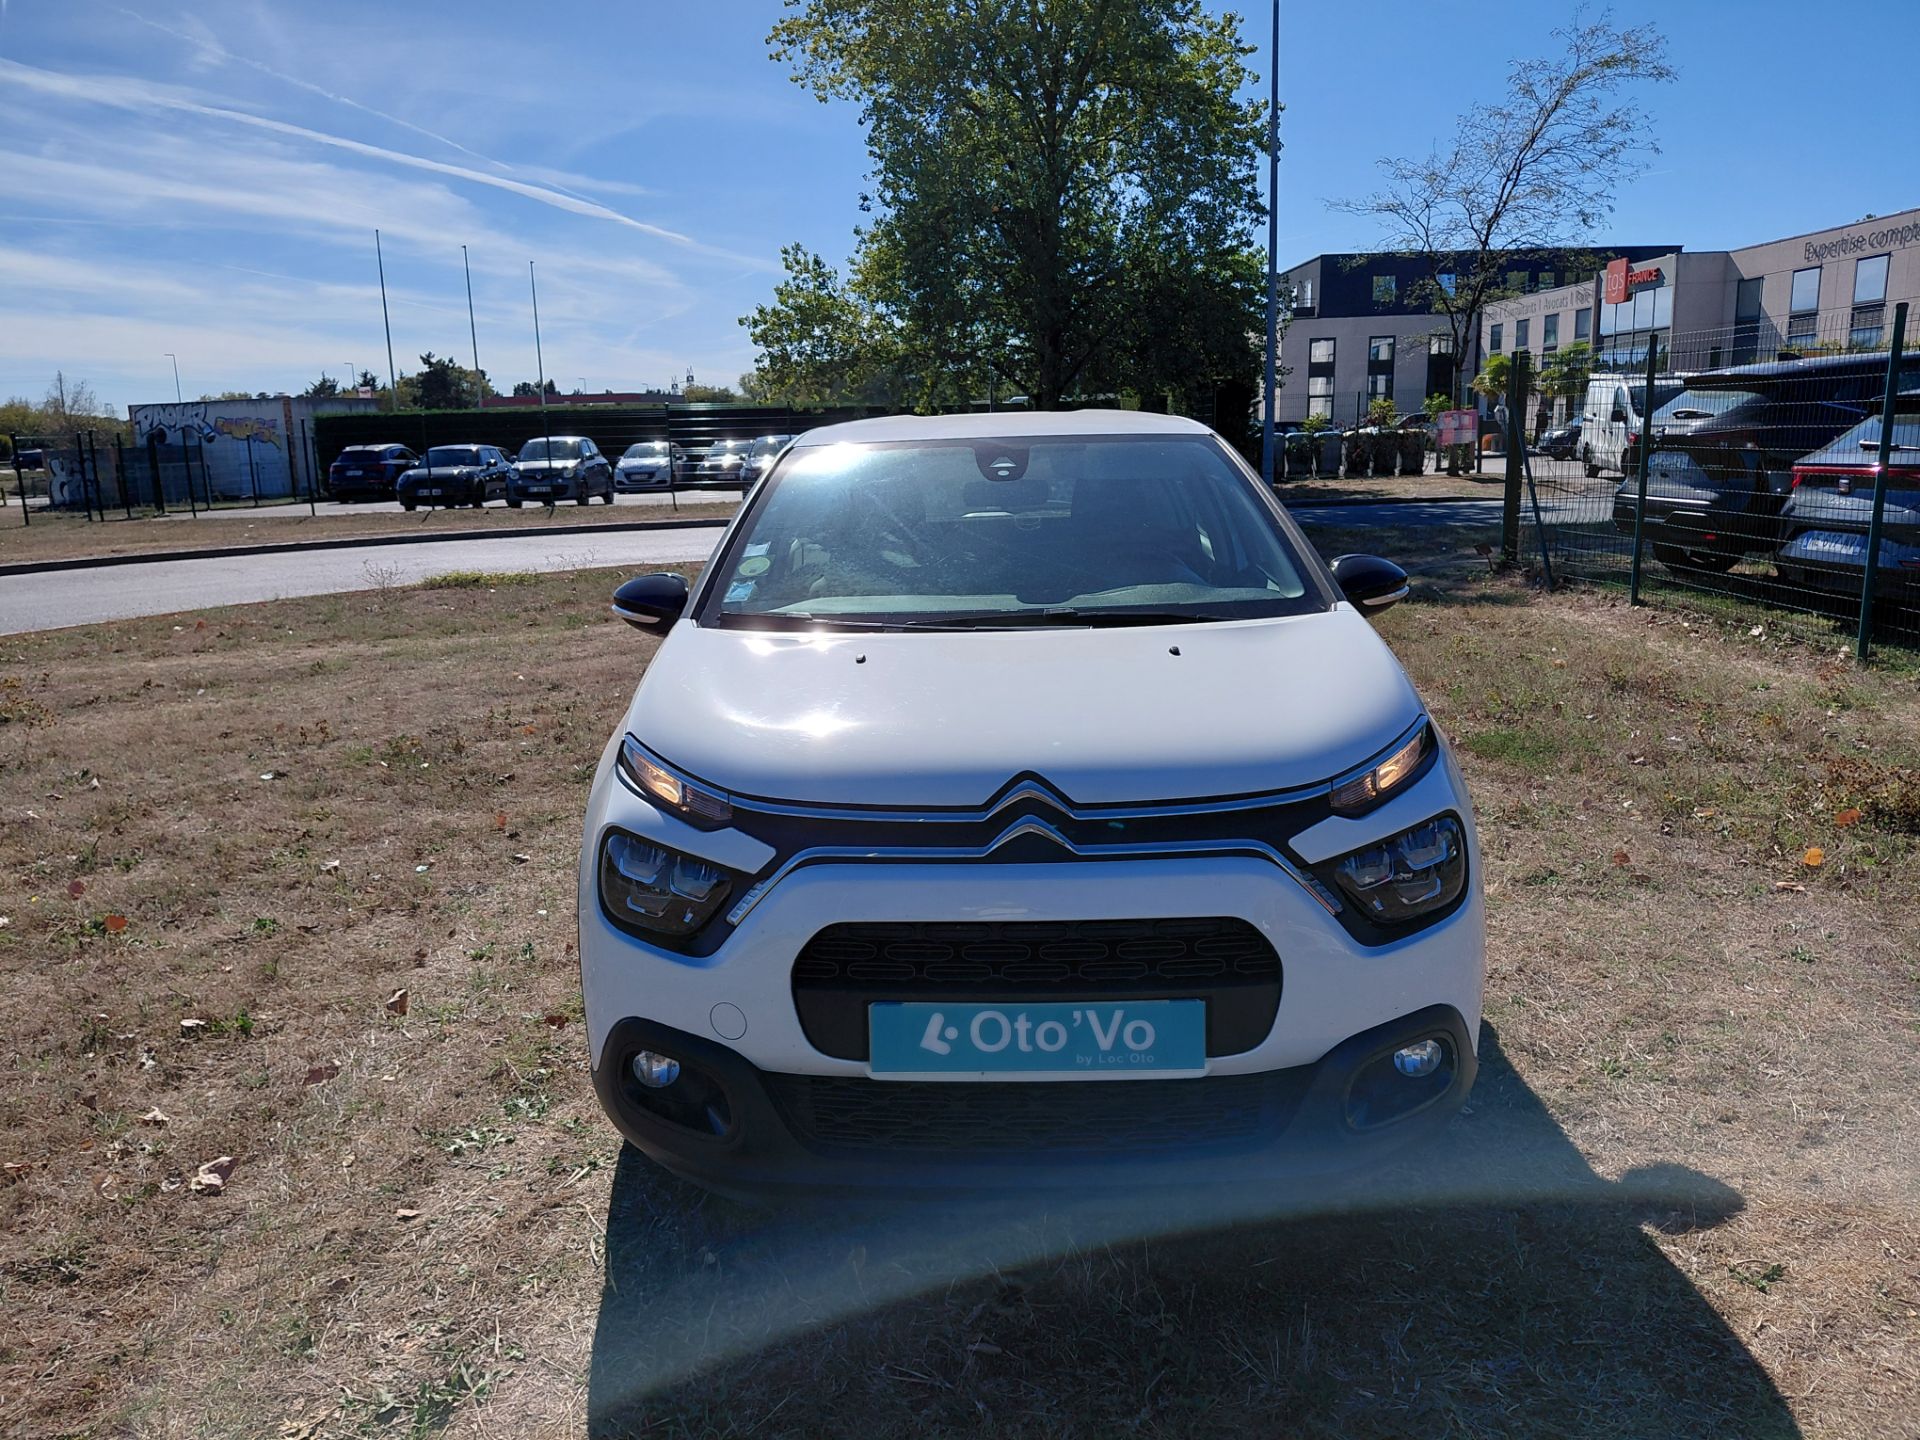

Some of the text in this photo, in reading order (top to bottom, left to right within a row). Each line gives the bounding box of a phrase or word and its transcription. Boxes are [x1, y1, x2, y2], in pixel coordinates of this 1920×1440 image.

[1804, 222, 1920, 263] Expertise compt
[1607, 272, 1624, 297] tgs
[1628, 268, 1659, 286] FRANCE
[970, 1010, 1155, 1052] Oto'Vo
[1076, 1053, 1093, 1066] by
